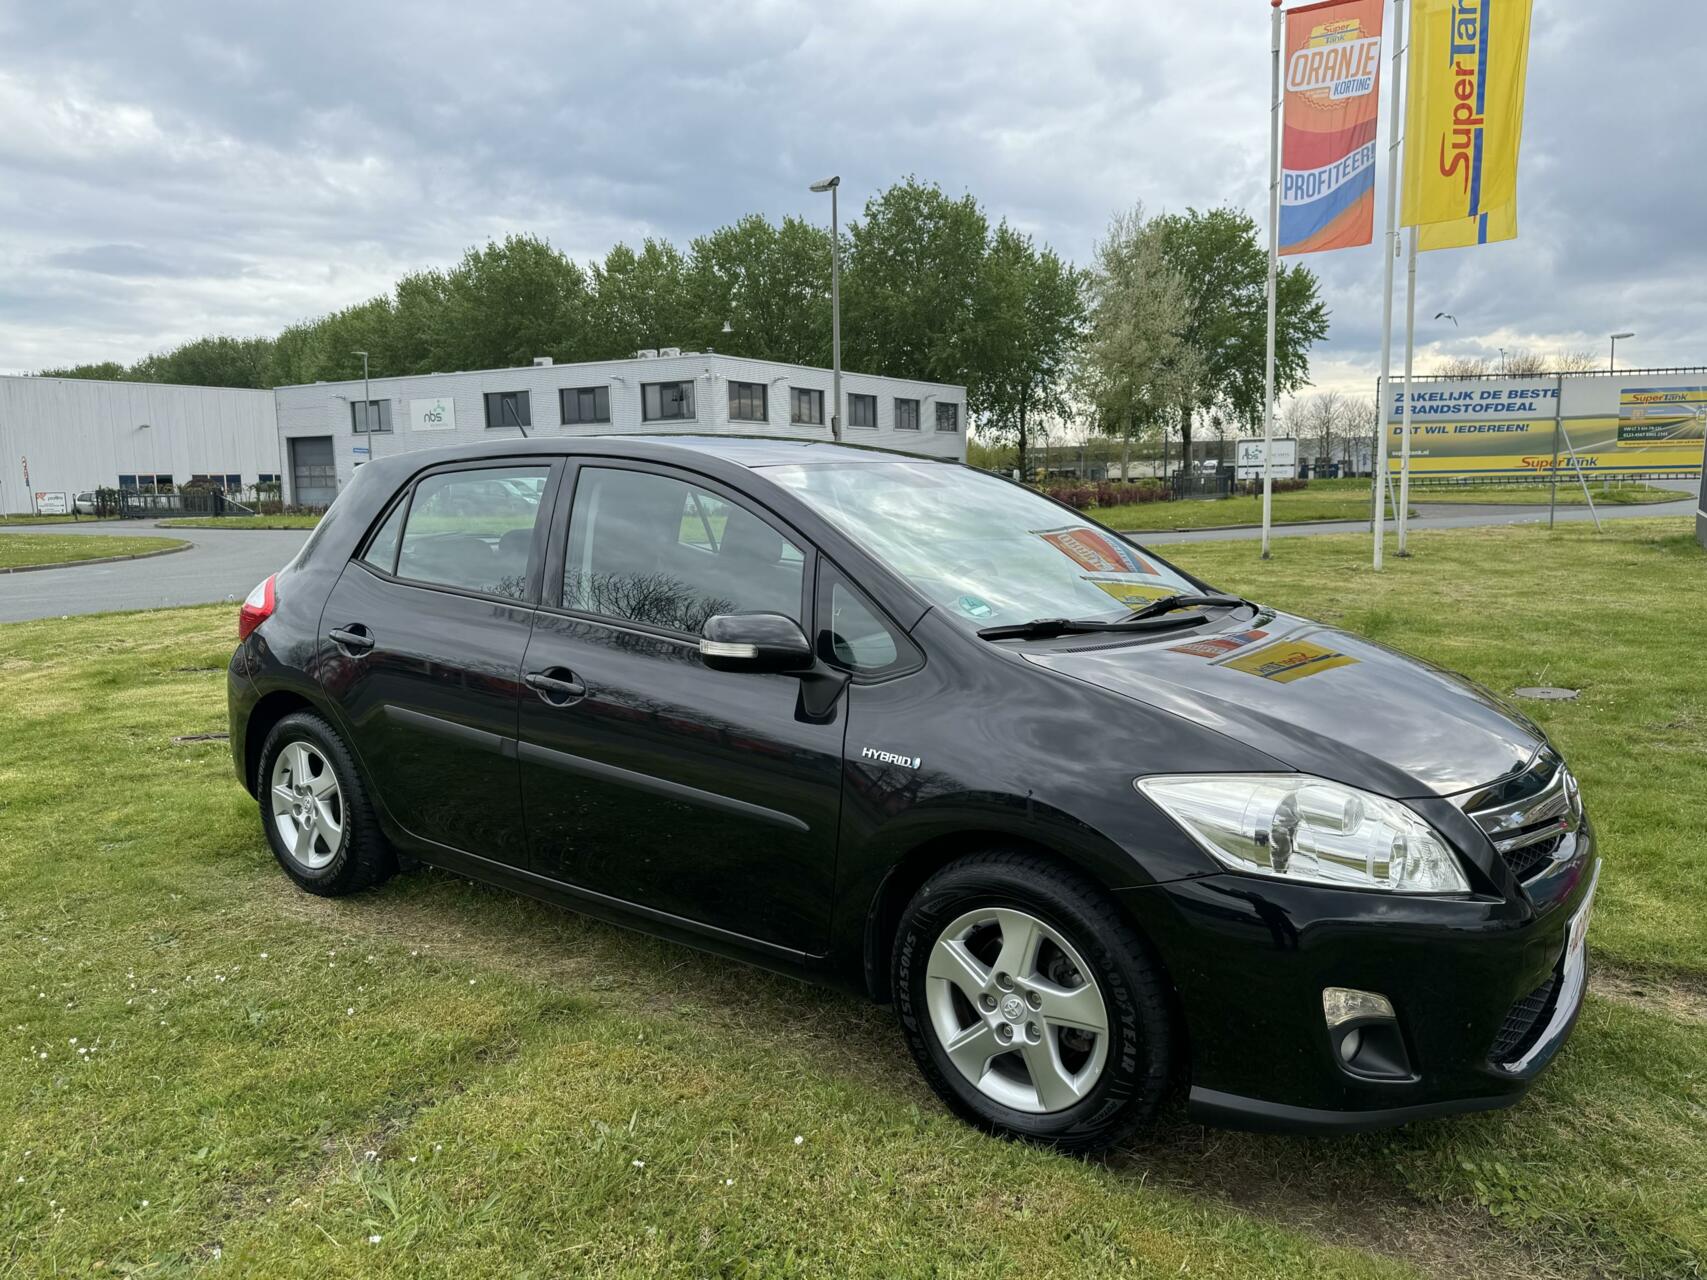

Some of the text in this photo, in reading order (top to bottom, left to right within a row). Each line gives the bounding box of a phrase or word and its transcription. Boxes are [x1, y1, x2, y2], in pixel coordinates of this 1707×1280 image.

[1323, 23, 1351, 34] Super
[1291, 41, 1378, 87] ORANJE
[1333, 77, 1371, 97] KORTING
[1284, 142, 1376, 201] PROFITEER!
[1479, 390, 1502, 400] DE
[1507, 388, 1560, 399] BESTE
[1632, 393, 1688, 405] SuperTank
[424, 410, 442, 423] nbs
[1393, 424, 1530, 435] DT WIL IEDEREEN!
[1515, 456, 1599, 472] SuperTank
[862, 747, 912, 767] HYBRID
